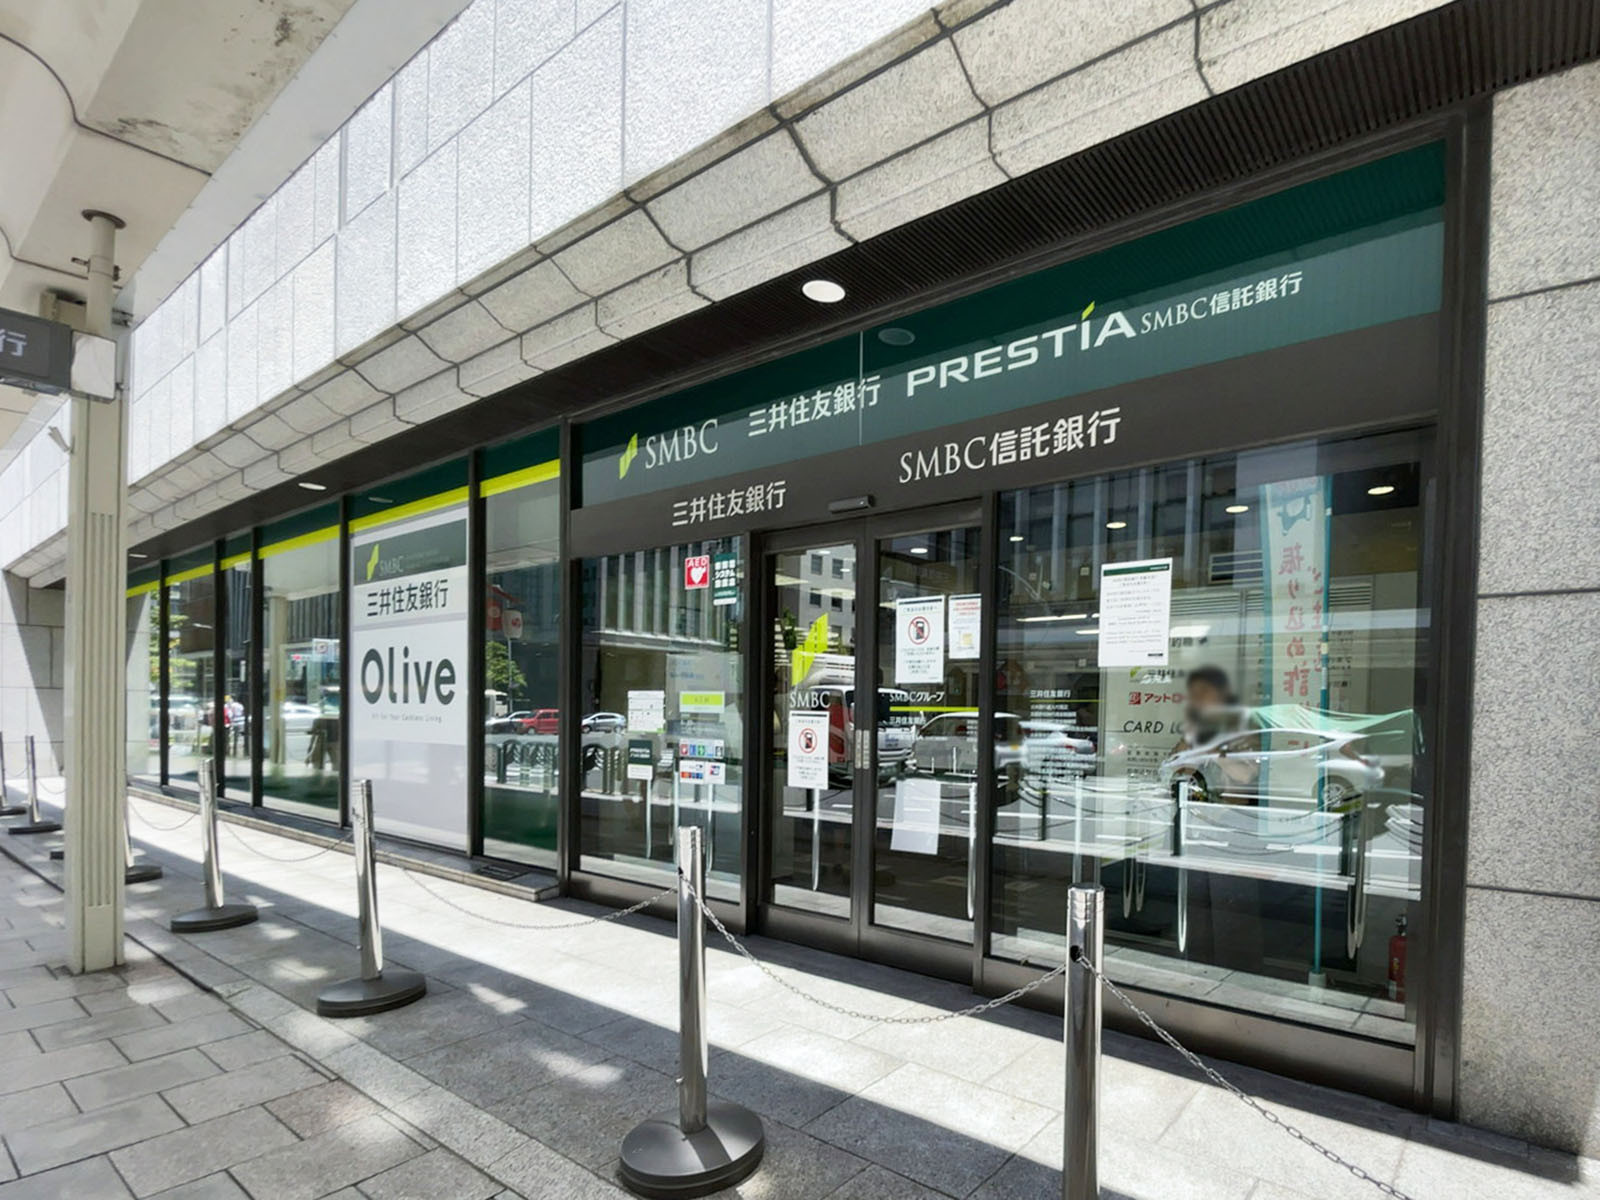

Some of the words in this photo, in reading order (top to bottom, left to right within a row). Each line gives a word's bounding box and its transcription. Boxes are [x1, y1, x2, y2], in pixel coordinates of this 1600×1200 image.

[644, 418, 719, 470] SMBC
[748, 375, 881, 437] 三井住友銀行
[1140, 271, 1303, 335] SMBC信託銀行
[671, 479, 787, 527] 三井住友銀行
[898, 406, 1121, 484] SMBC信託銀行
[688, 556, 708, 569] AED
[366, 579, 449, 617] 三井住友銀行
[361, 645, 456, 706] Olive
[789, 691, 831, 709] SMBC
[888, 691, 945, 704] SMBCグループ
[1123, 720, 1164, 734] CARD
